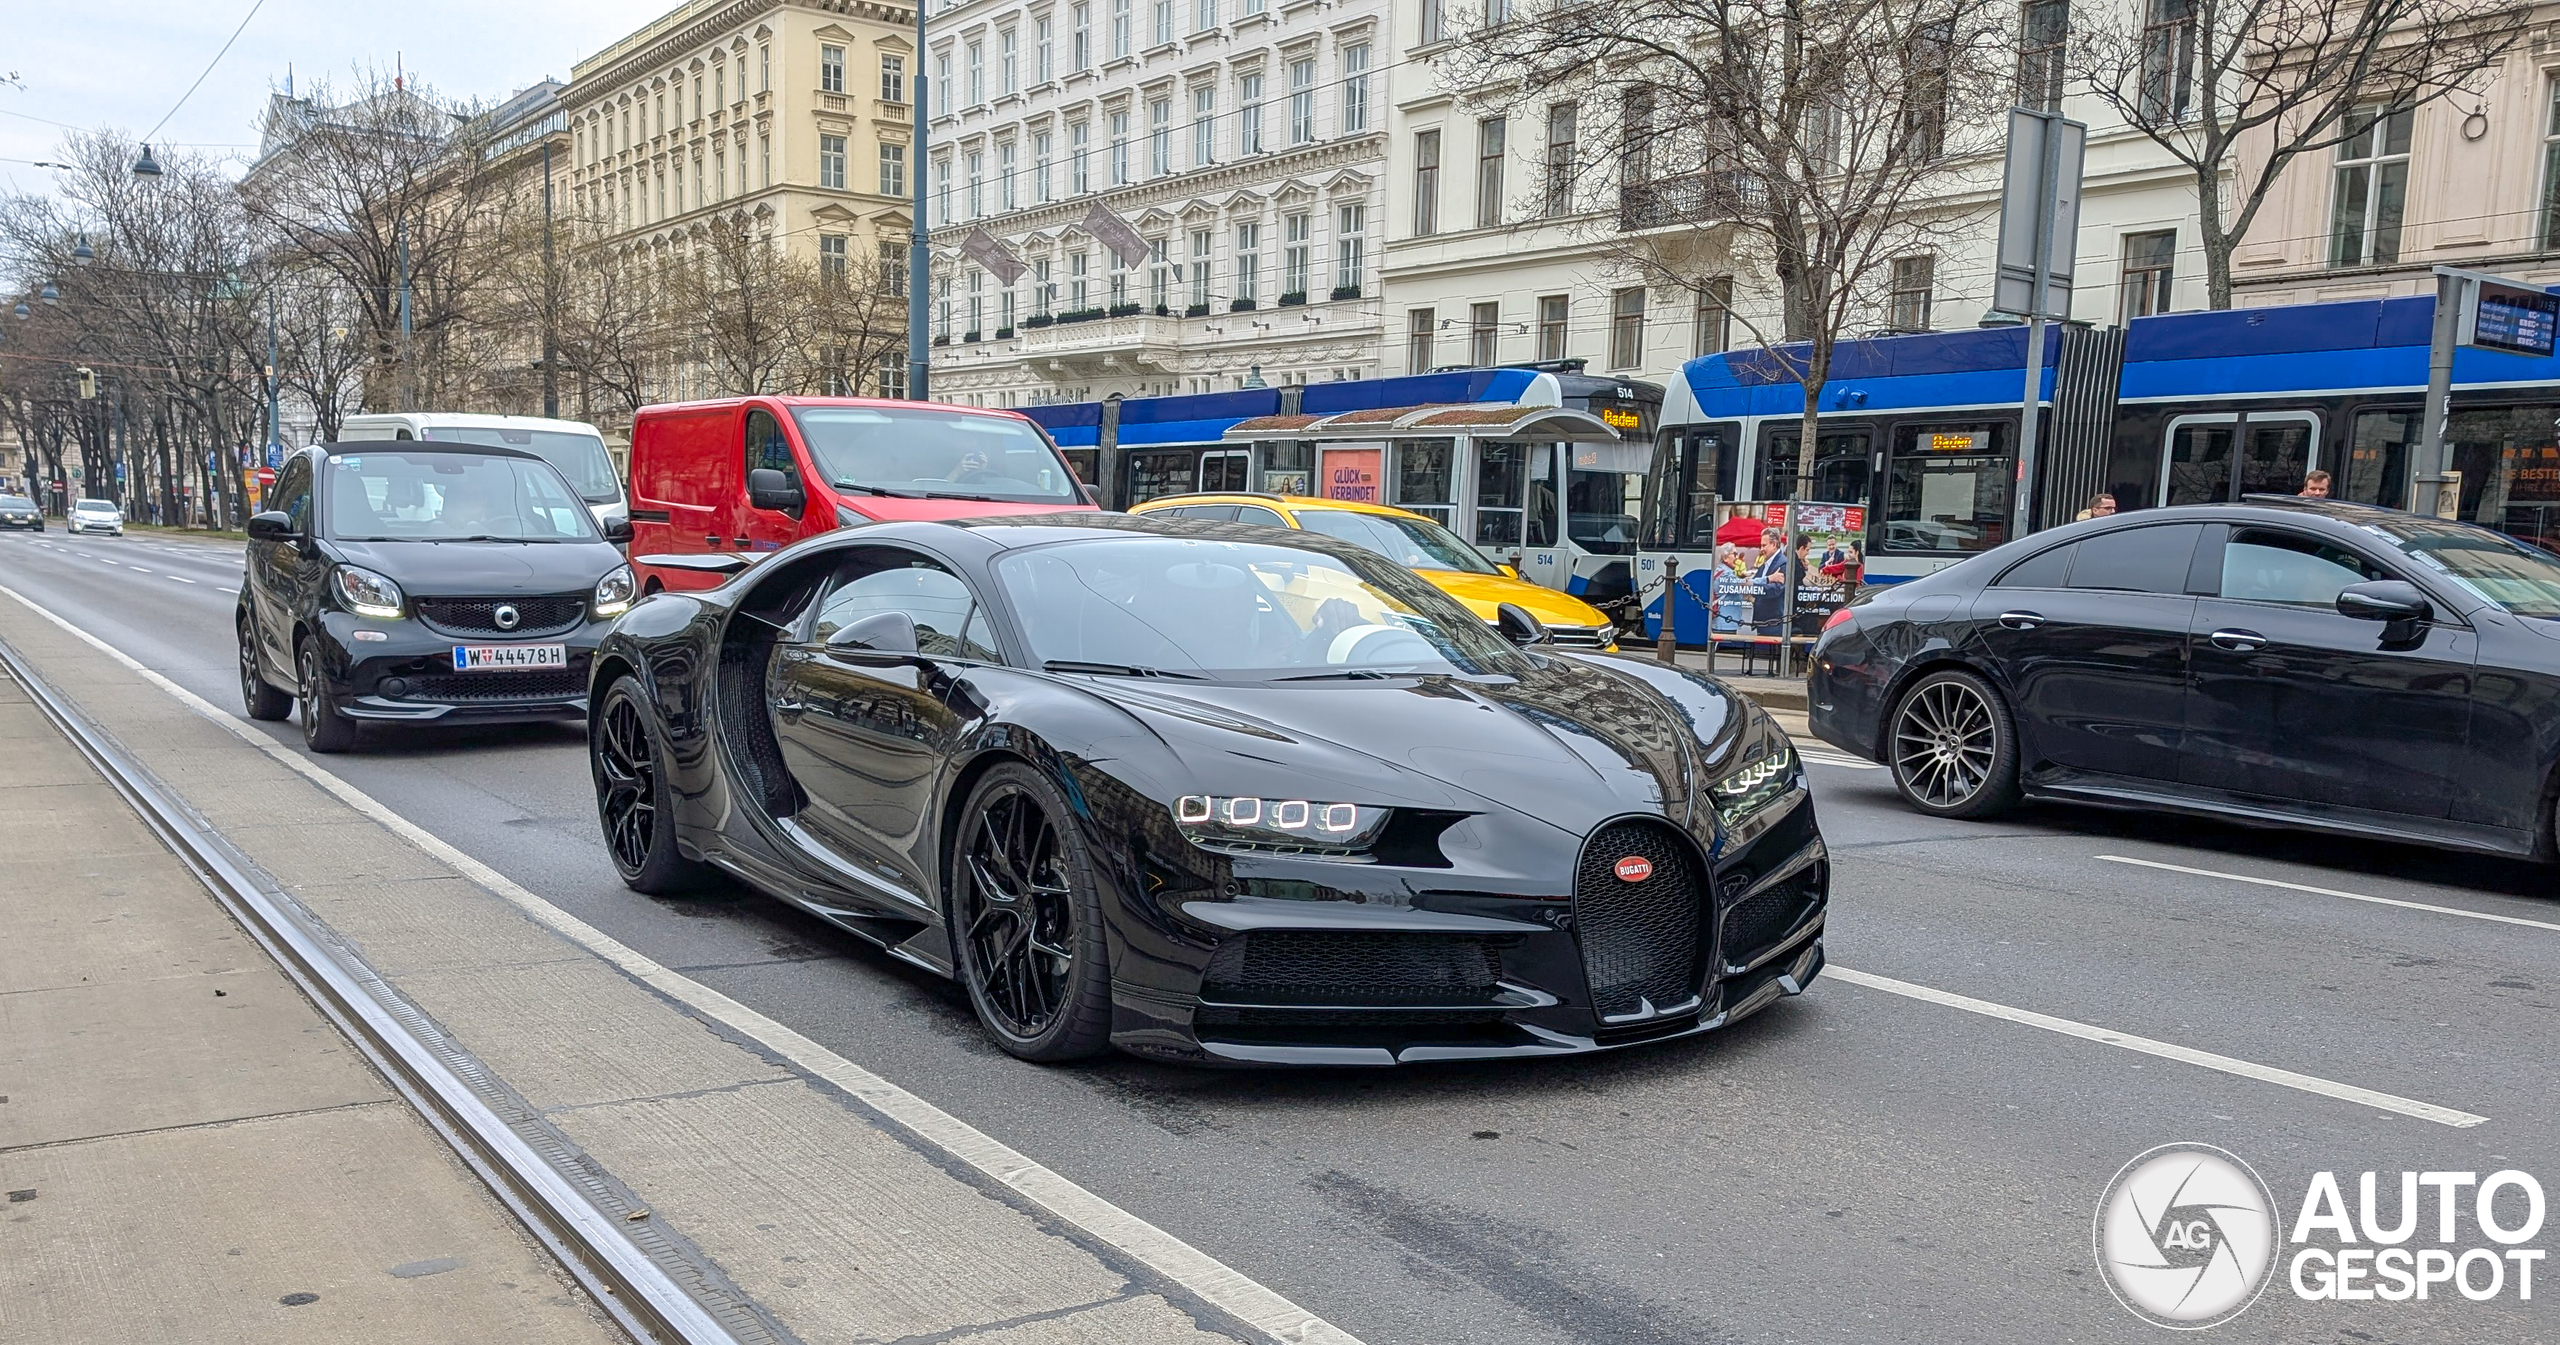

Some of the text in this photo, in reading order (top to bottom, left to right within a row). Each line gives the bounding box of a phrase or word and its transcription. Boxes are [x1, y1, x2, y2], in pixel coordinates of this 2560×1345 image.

[1617, 387, 1633, 399] 514
[1604, 410, 1638, 427] Baden
[1933, 435, 1972, 449] Baden
[1334, 467, 1361, 484] GLÜCK
[2521, 468, 2559, 479] BESTE
[1330, 486, 1376, 501] VERBINDET
[1537, 554, 1553, 565] 514
[1641, 559, 1655, 571] 501
[1719, 585, 1767, 595] ZUSAMMEN.
[468, 649, 480, 666] W
[1620, 864, 1649, 876] BUGATTI
